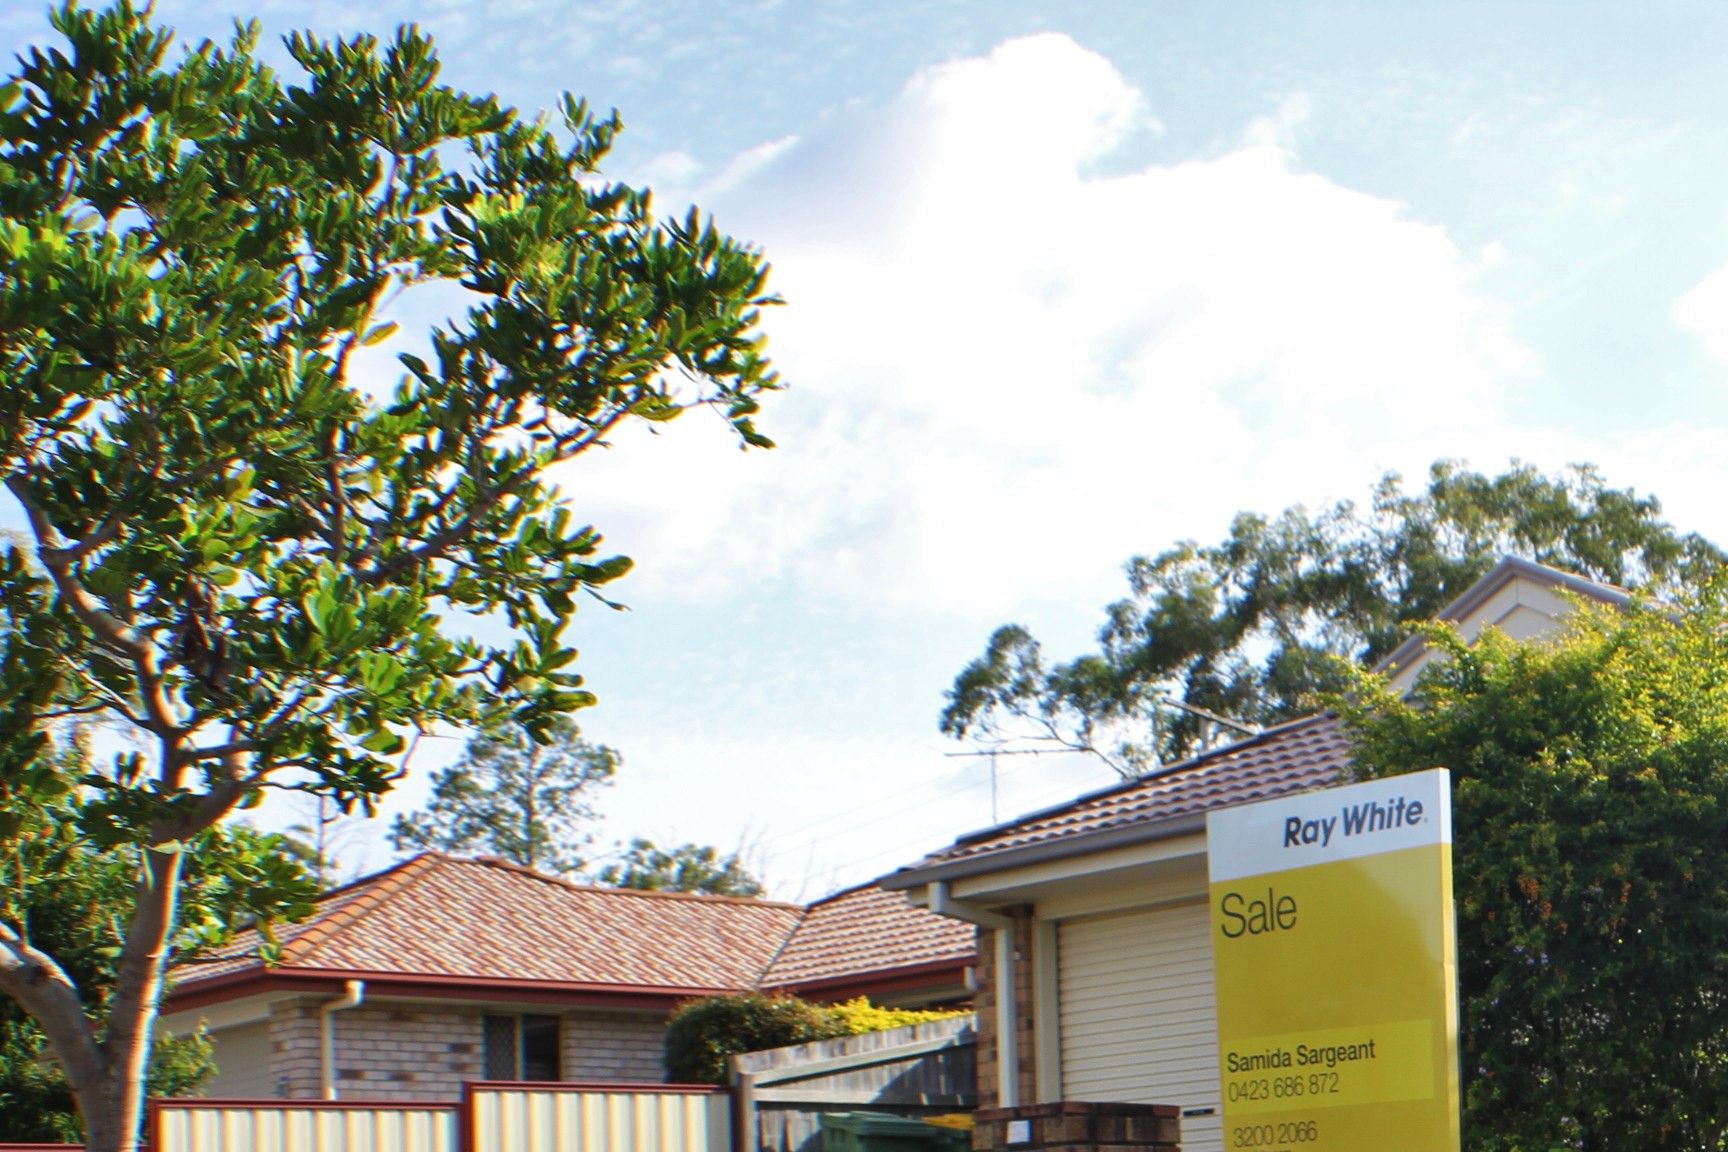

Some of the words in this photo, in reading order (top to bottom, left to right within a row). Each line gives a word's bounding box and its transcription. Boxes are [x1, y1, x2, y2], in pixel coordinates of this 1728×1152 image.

[1284, 816, 1337, 848] Ray
[1343, 797, 1423, 836] White
[1220, 887, 1297, 938] Sale
[1227, 1048, 1292, 1072] Samida
[1297, 1039, 1376, 1068] Sargeant
[1229, 1078, 1269, 1102] 0423
[1274, 1076, 1304, 1098] 686
[1309, 1072, 1339, 1094] 872
[1233, 1124, 1274, 1148] 3200
[1278, 1120, 1318, 1144] 2066
